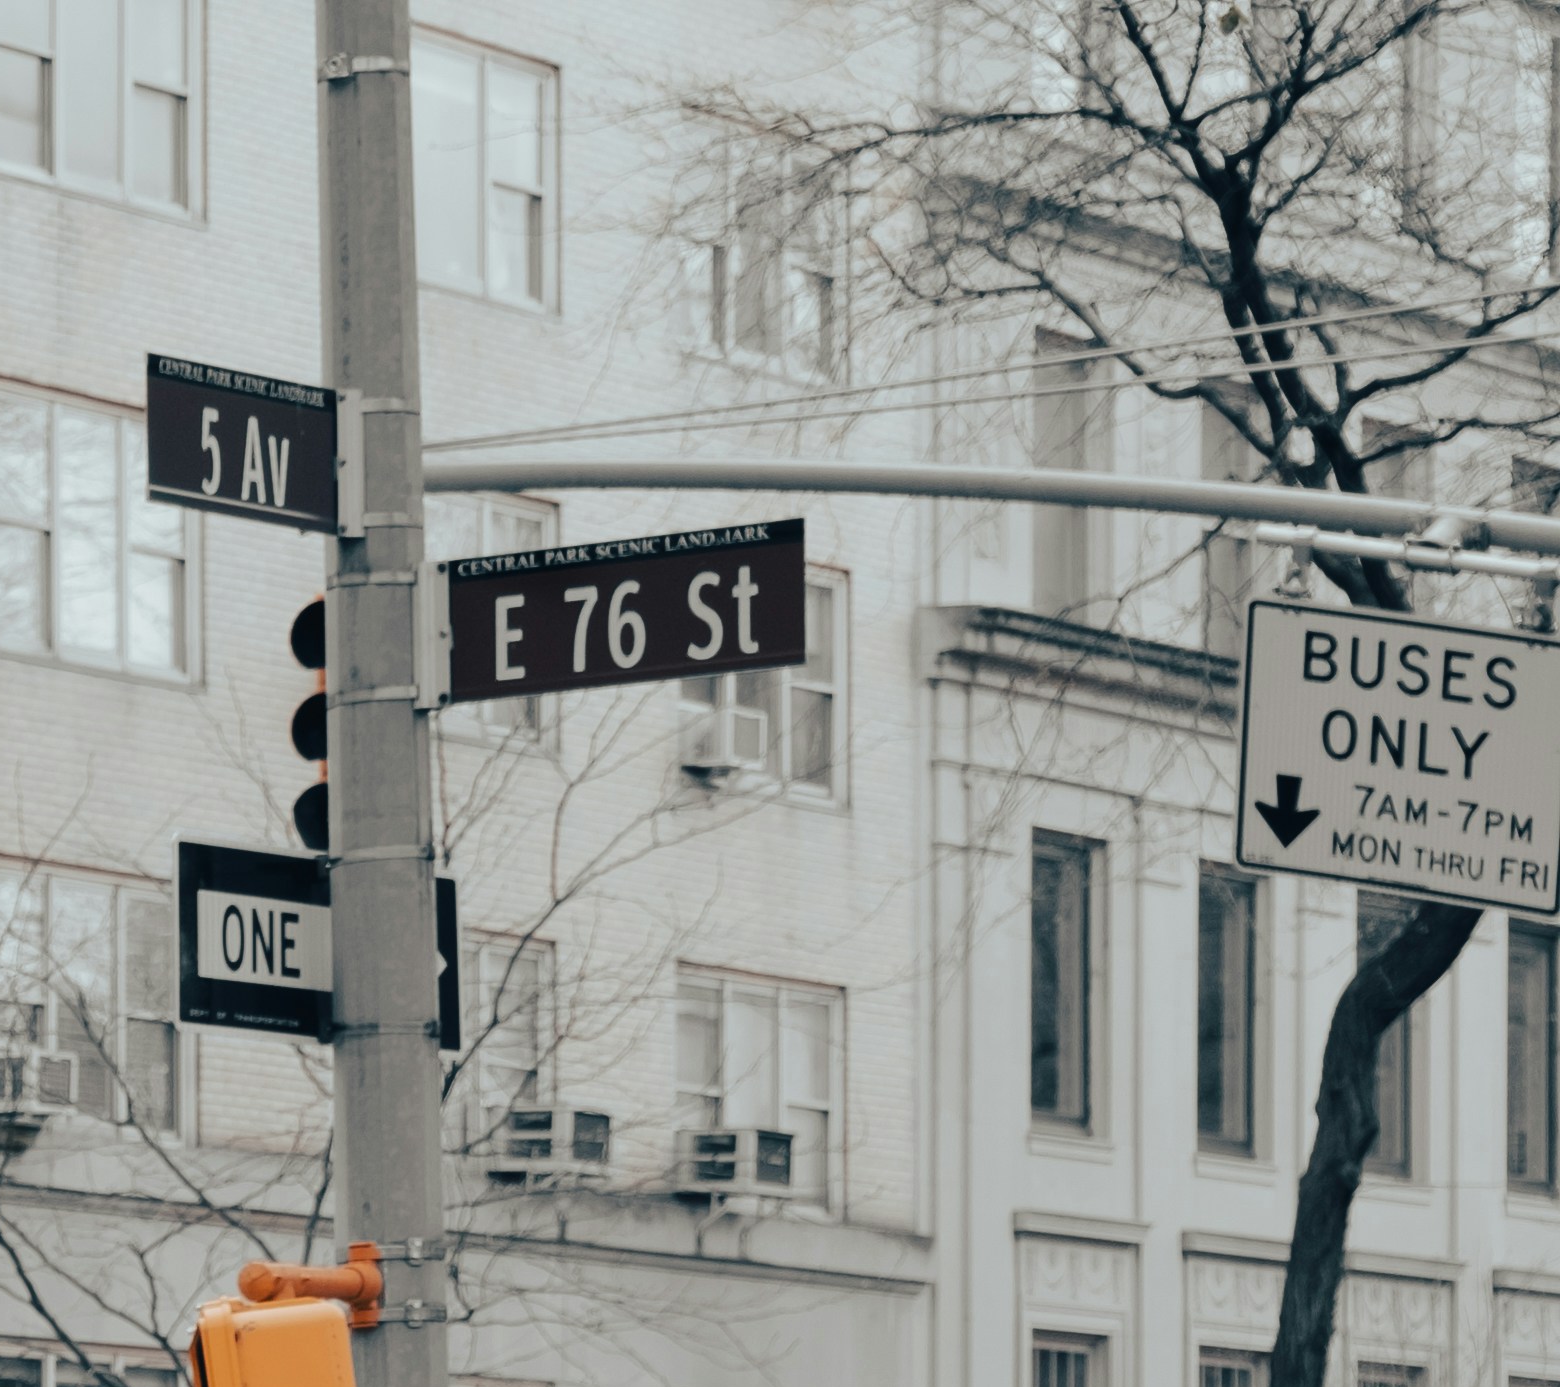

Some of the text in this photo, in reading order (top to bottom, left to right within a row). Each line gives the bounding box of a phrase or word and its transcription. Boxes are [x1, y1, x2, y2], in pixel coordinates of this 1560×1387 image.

[200, 407, 290, 507] 5 Av
[457, 555, 540, 577] CENTRAL
[544, 548, 589, 566] PARK
[595, 537, 660, 559] SCENIC
[495, 565, 759, 681] E 76 St
[1303, 630, 1517, 709] BUSES
[1322, 709, 1490, 779] ONLY
[1332, 831, 1549, 892] MON THRU FRI
[222, 904, 301, 978] ONE
